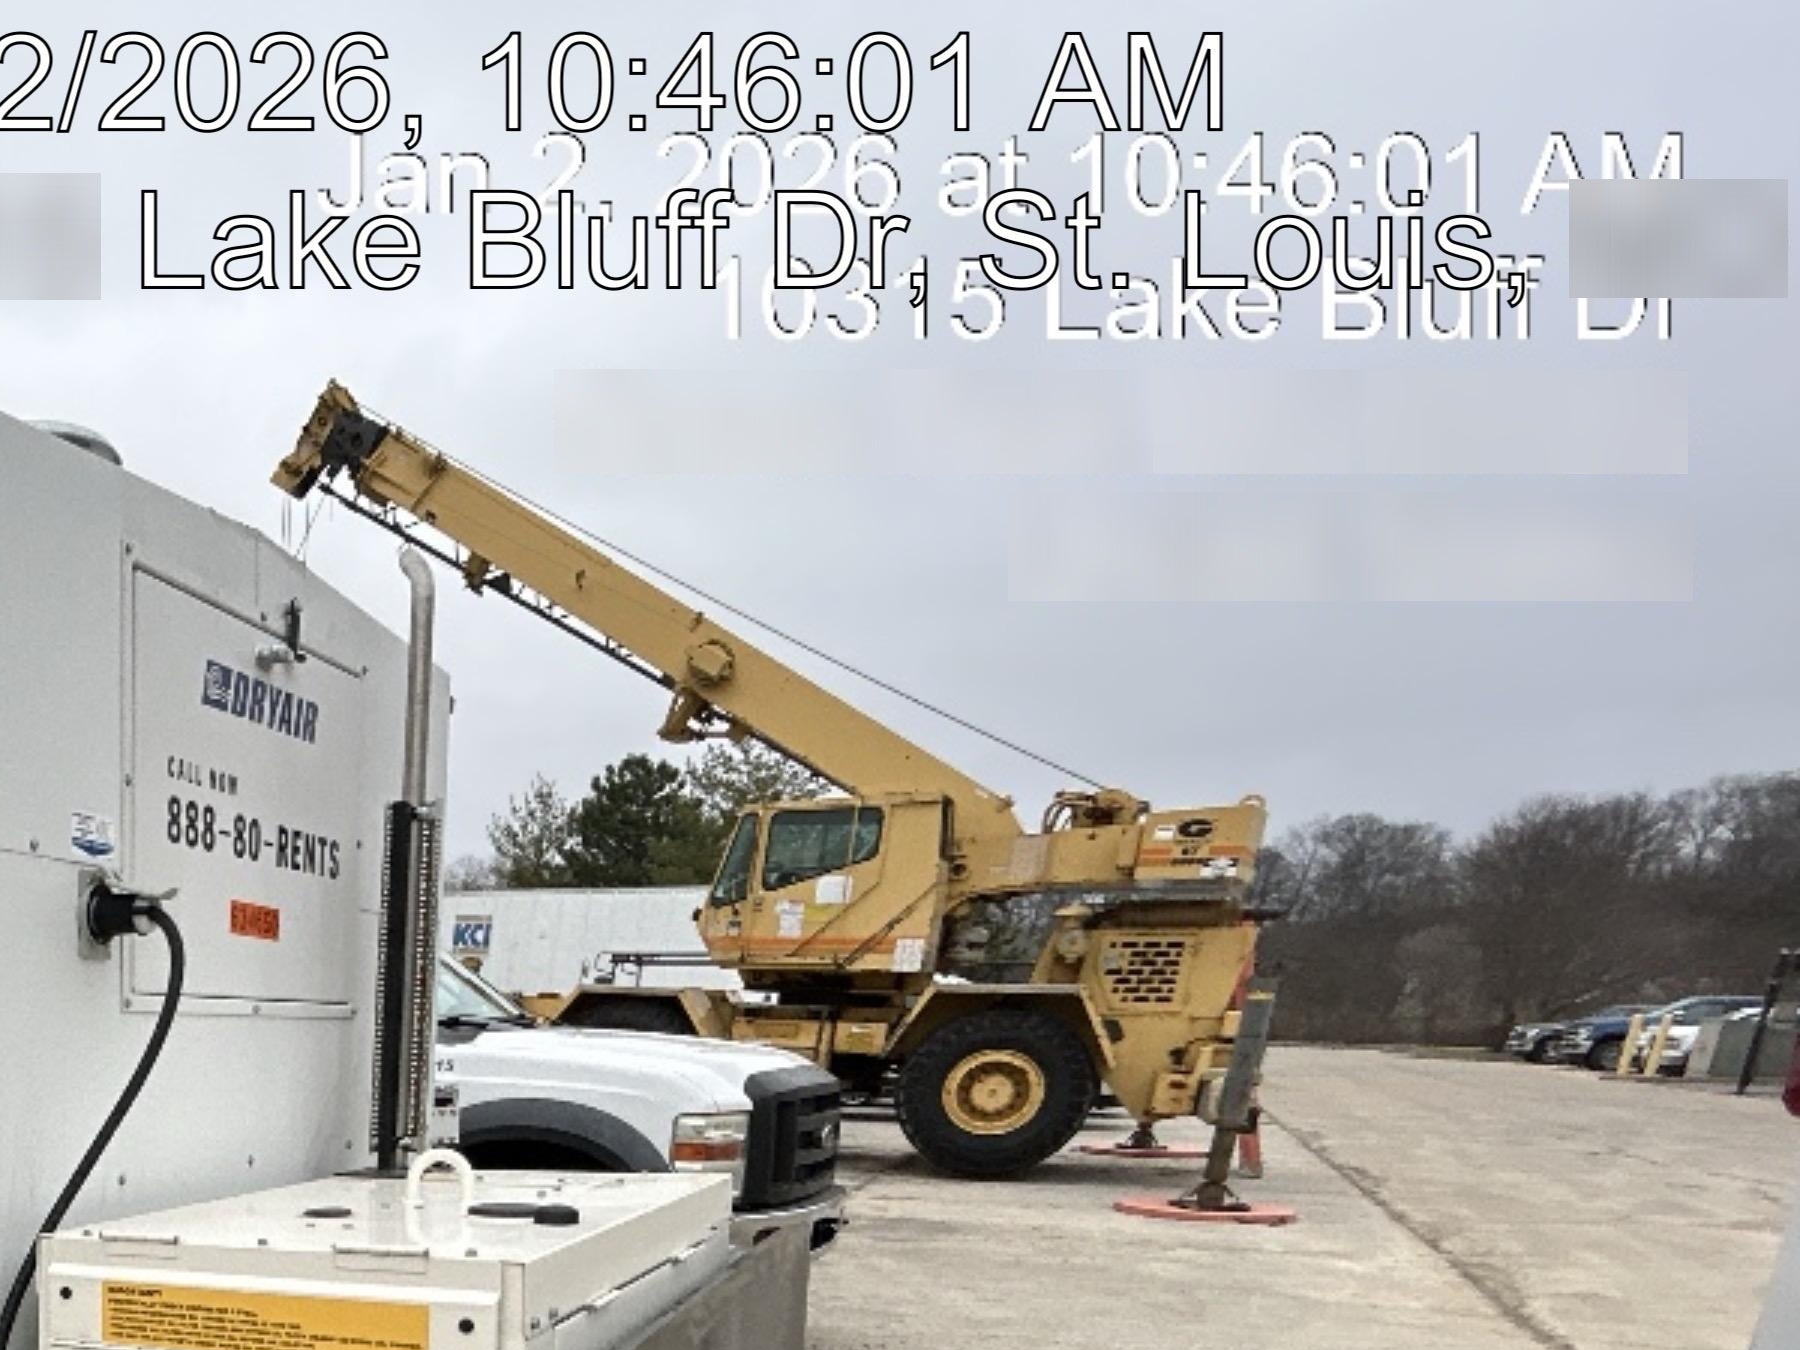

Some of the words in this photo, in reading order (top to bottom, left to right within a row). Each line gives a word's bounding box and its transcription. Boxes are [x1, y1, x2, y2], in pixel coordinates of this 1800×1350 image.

[230, 670, 319, 745] DRYAIR
[167, 755, 202, 787] CALL
[209, 768, 239, 796] NOW
[167, 794, 341, 880] 888-80-RENTS
